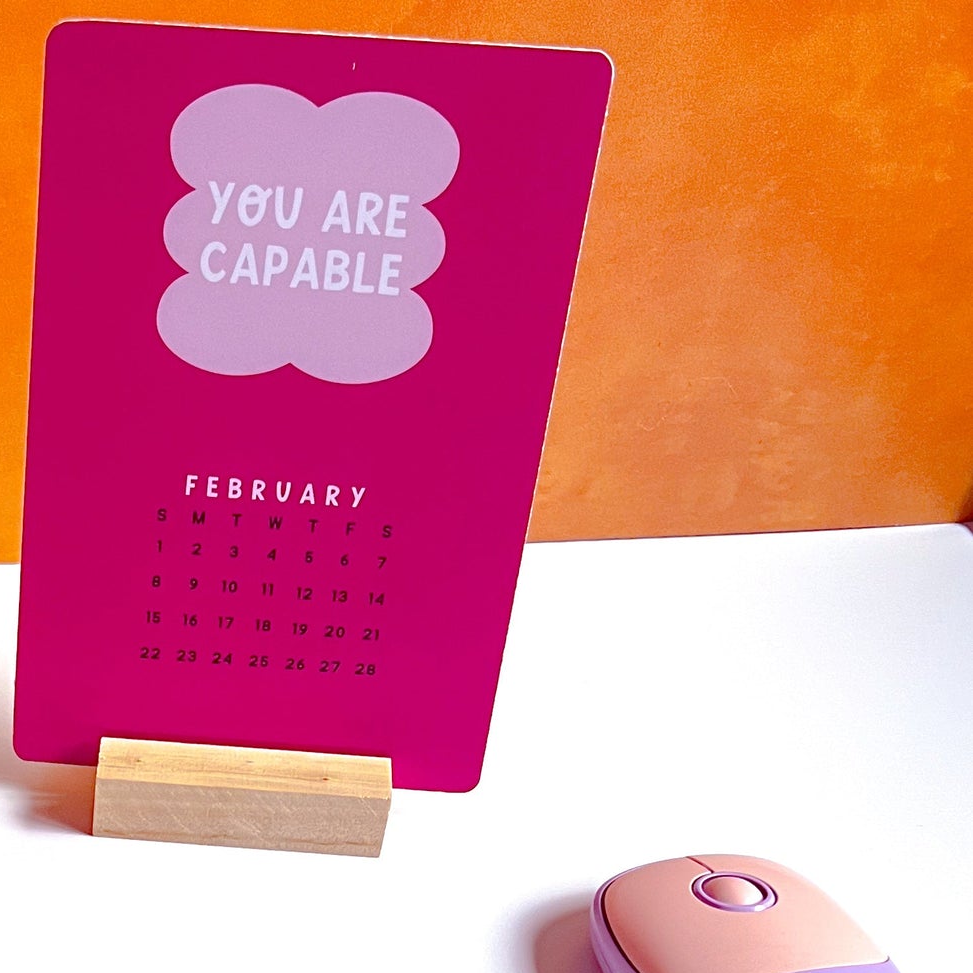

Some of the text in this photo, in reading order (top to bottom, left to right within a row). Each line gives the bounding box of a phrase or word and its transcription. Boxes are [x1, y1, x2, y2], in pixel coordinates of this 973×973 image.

[208, 180, 411, 239] YOU ARE
[199, 240, 404, 297] CAPABLE
[184, 473, 367, 509] FEBRUARY
[157, 508, 393, 539] S M T W T F S
[156, 539, 388, 570] 1 2 3 4 5 6 7
[151, 575, 385, 606] 8 9 10 11 12 13 14
[145, 610, 380, 641] 15 16 17 18 19 20 21
[139, 646, 376, 676] 22 23 24 25 26 27 28
